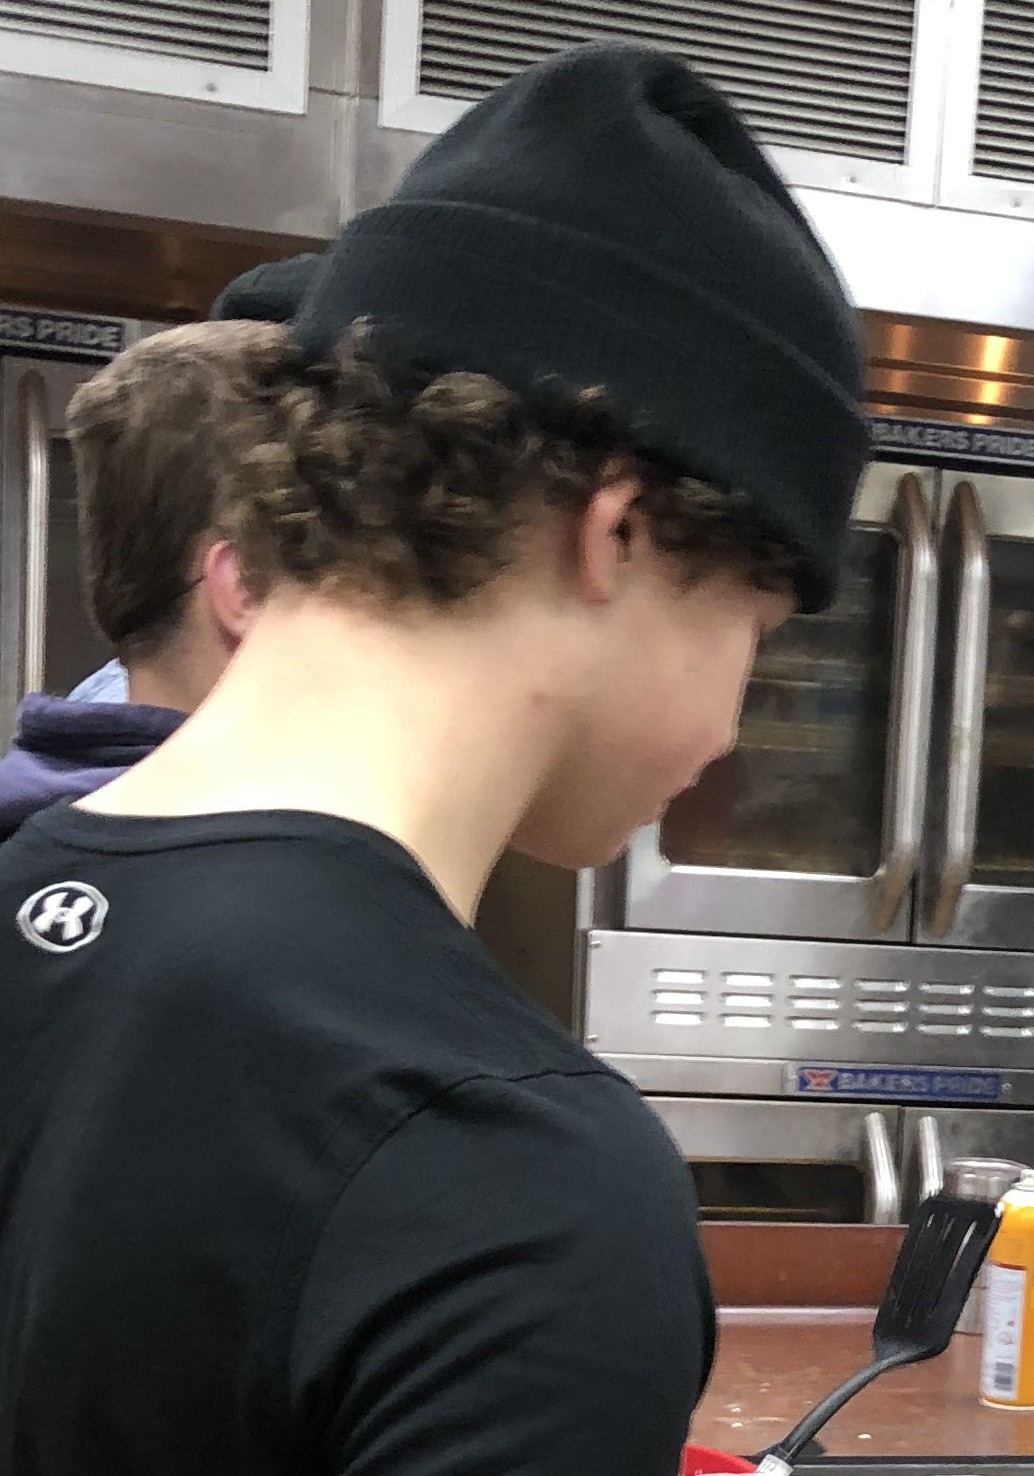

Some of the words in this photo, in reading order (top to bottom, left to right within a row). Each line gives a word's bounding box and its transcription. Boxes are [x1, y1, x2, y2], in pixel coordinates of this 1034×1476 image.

[37, 318, 121, 347] PRIDE
[872, 422, 969, 450] BAKERS
[837, 1072, 928, 1094] BAKERS
[932, 1075, 996, 1096] PRIDE
